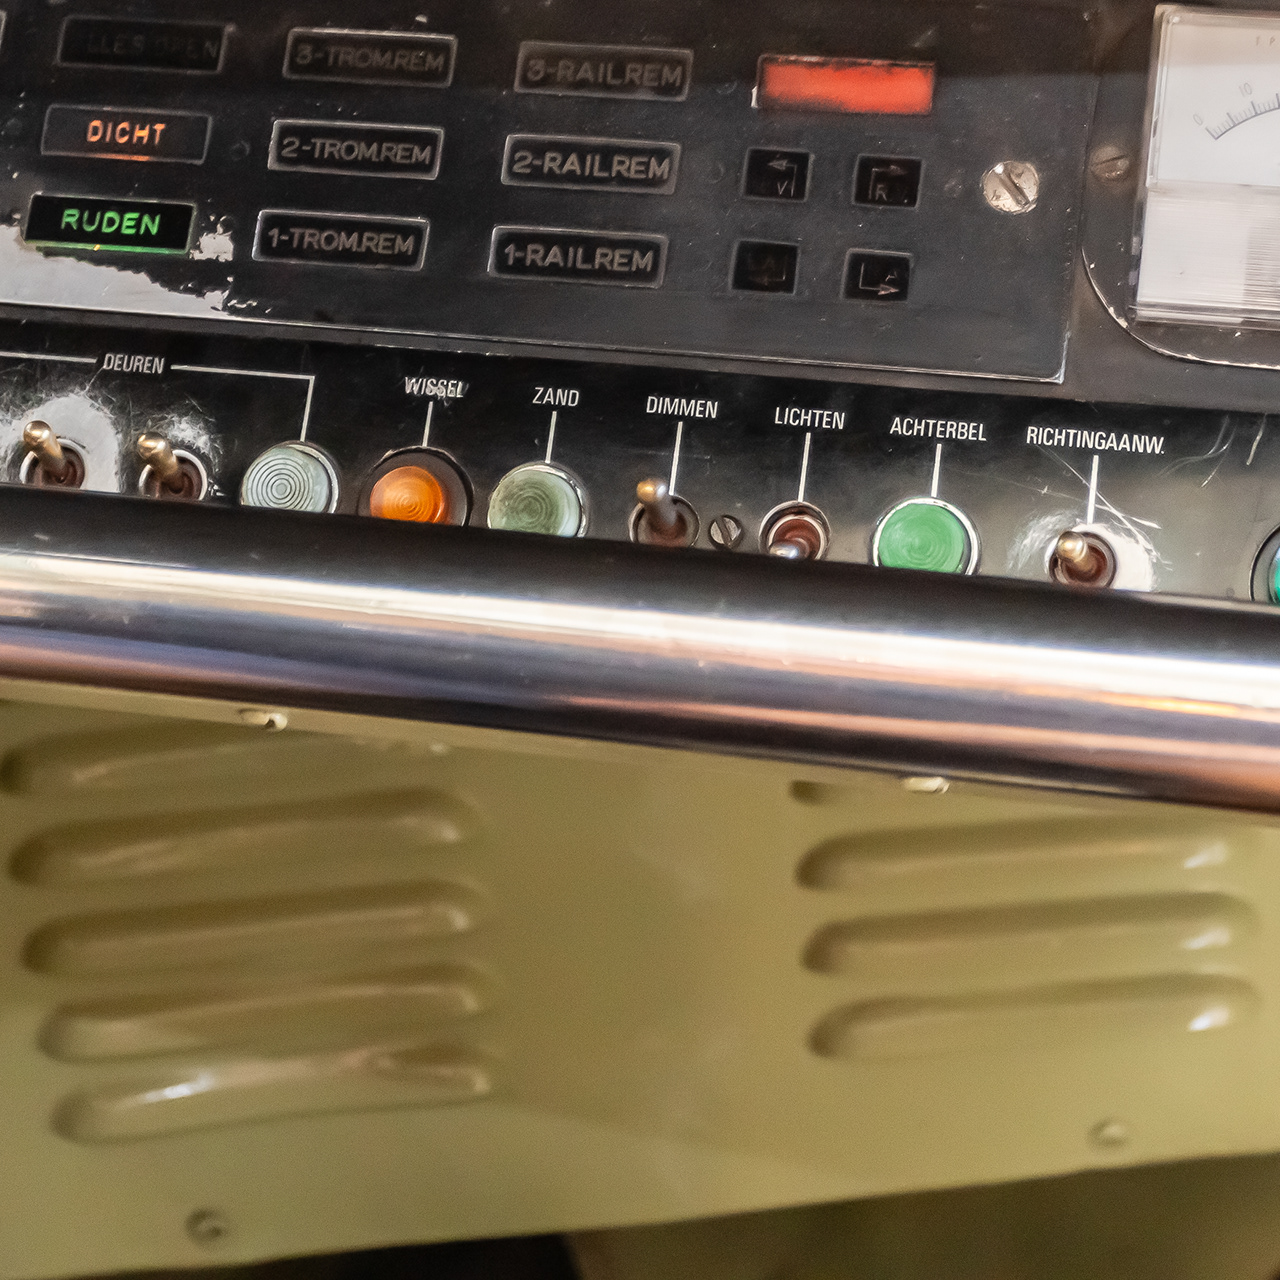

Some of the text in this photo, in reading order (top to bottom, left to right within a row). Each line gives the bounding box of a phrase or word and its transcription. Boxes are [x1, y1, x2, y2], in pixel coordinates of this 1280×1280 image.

[527, 58, 683, 88] 3-RAILREM
[1238, 82, 1253, 96] 10
[87, 119, 166, 145] DICHT
[1193, 114, 1204, 127] 0
[513, 150, 670, 182] 2-RAILREM
[504, 243, 654, 275] 1-RAILREM
[102, 353, 165, 376] DEUREN
[404, 376, 464, 399] WISSEL
[532, 386, 580, 407] ZAND
[646, 395, 719, 419] DIMMEN
[774, 406, 845, 430] LICHTEN
[889, 416, 987, 442] ACHTERBEL
[1026, 425, 1166, 455] RICHTINGAANW.
